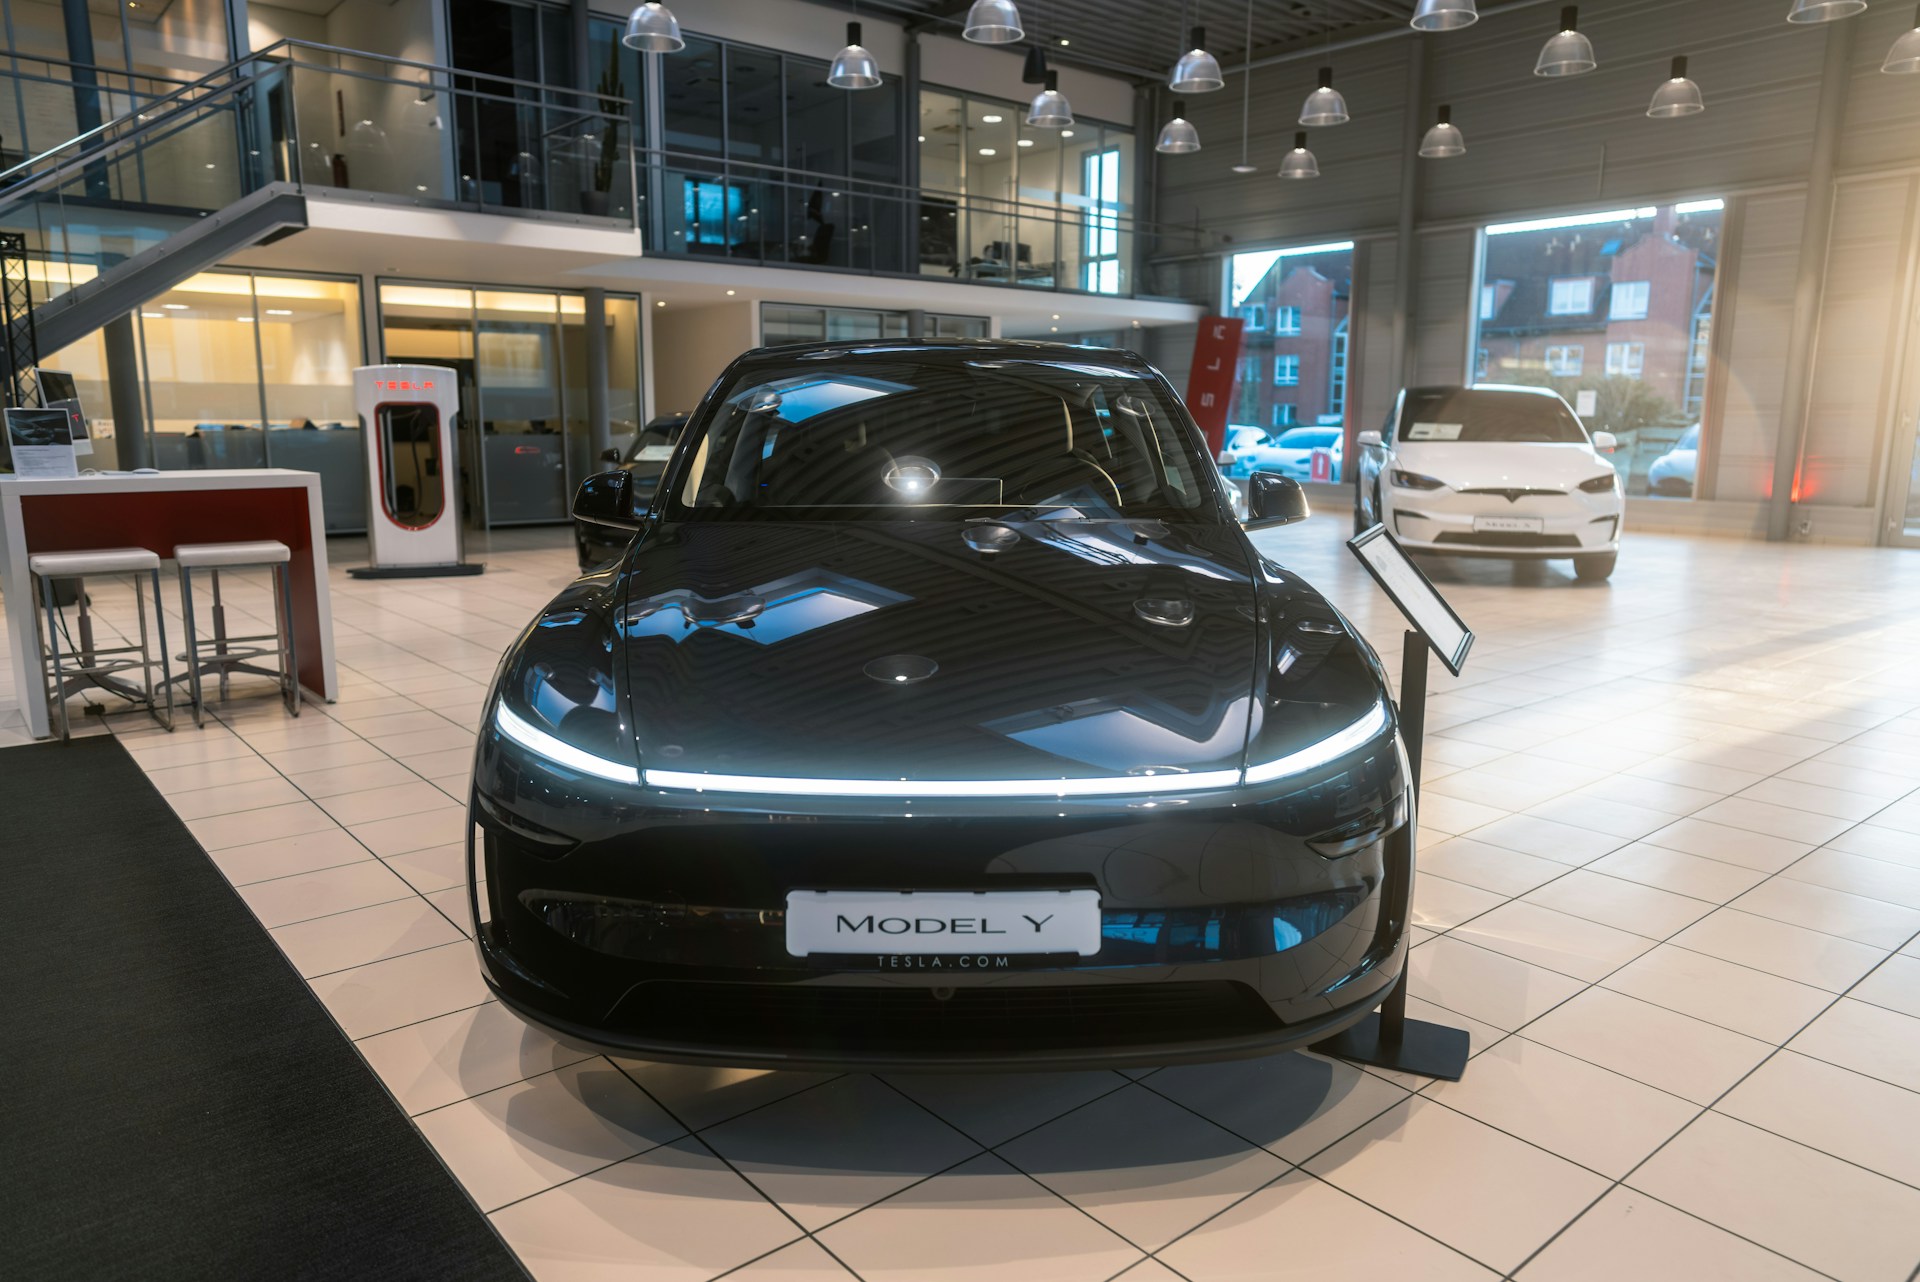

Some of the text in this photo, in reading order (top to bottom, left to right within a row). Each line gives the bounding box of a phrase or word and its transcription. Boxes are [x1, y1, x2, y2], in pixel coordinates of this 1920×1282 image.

[375, 381, 434, 391] TESLA
[1201, 325, 1226, 441] SLA
[1021, 914, 1054, 933] Y
[877, 955, 1009, 968] TESLA.COM
